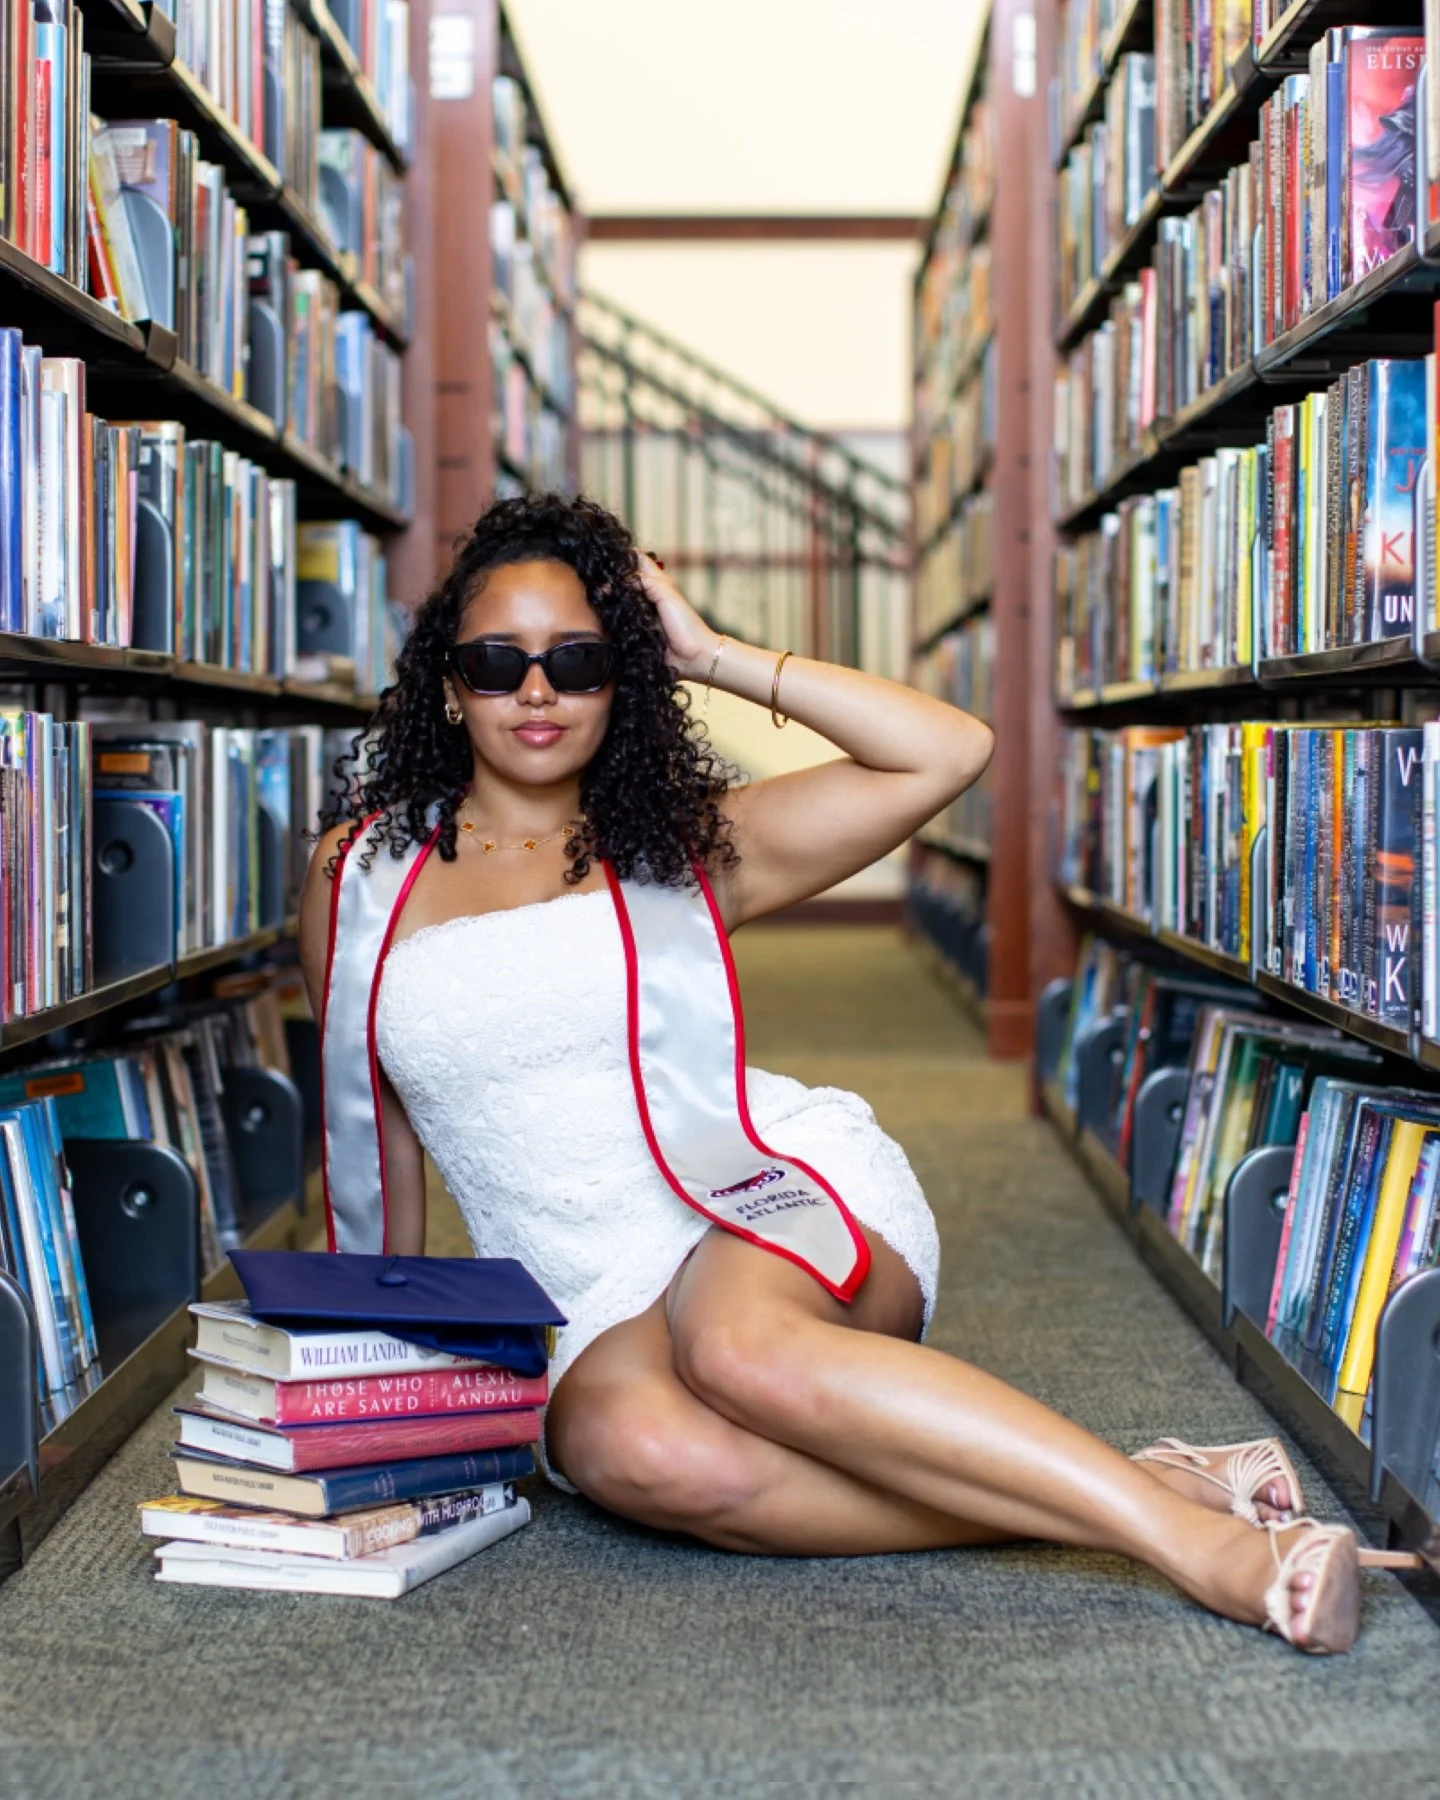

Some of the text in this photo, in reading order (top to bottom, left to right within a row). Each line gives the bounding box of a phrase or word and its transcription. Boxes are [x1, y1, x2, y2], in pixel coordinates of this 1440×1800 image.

[1350, 380, 1359, 474] JAYNE ANN
[1386, 924, 1409, 952] W
[1385, 956, 1406, 1002] K
[736, 1189, 811, 1214] FLORIDA
[746, 1198, 828, 1221] ATLANTIC
[300, 1342, 409, 1367] WILLIAM LANDAY
[307, 1381, 367, 1399] THOSE
[378, 1376, 423, 1393] WHO
[452, 1371, 516, 1387] ALEXIS
[311, 1396, 419, 1417] ARE SAVED
[447, 1389, 522, 1408] LANDAU
